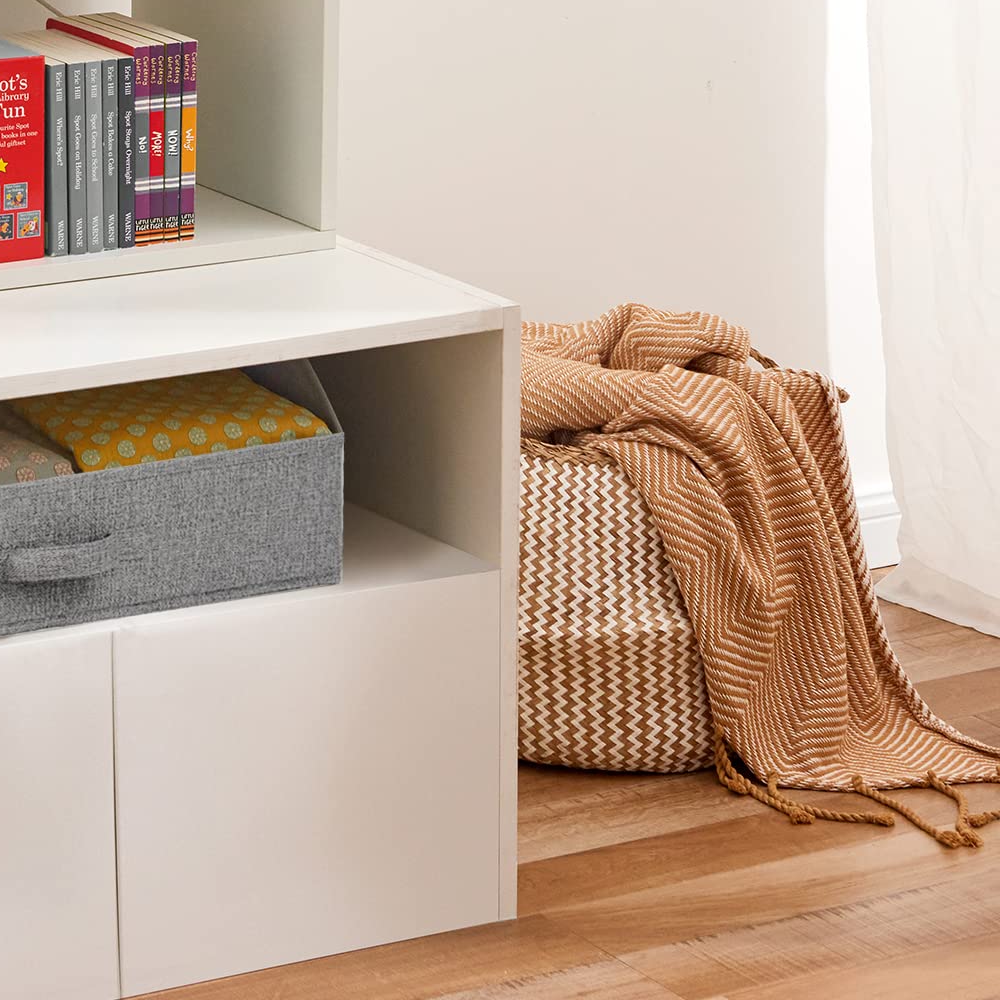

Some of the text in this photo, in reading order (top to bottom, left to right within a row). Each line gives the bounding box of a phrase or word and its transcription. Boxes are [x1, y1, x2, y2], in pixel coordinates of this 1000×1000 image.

[16, 122, 30, 131] Spot
[7, 139, 26, 148] giftset
[124, 128, 132, 148] Stays
[139, 136, 148, 153] No!
[151, 131, 162, 157] MORE!
[168, 129, 178, 156] NOW!
[184, 128, 195, 152] Why?
[75, 151, 81, 160] on
[124, 149, 132, 185] Overnight
